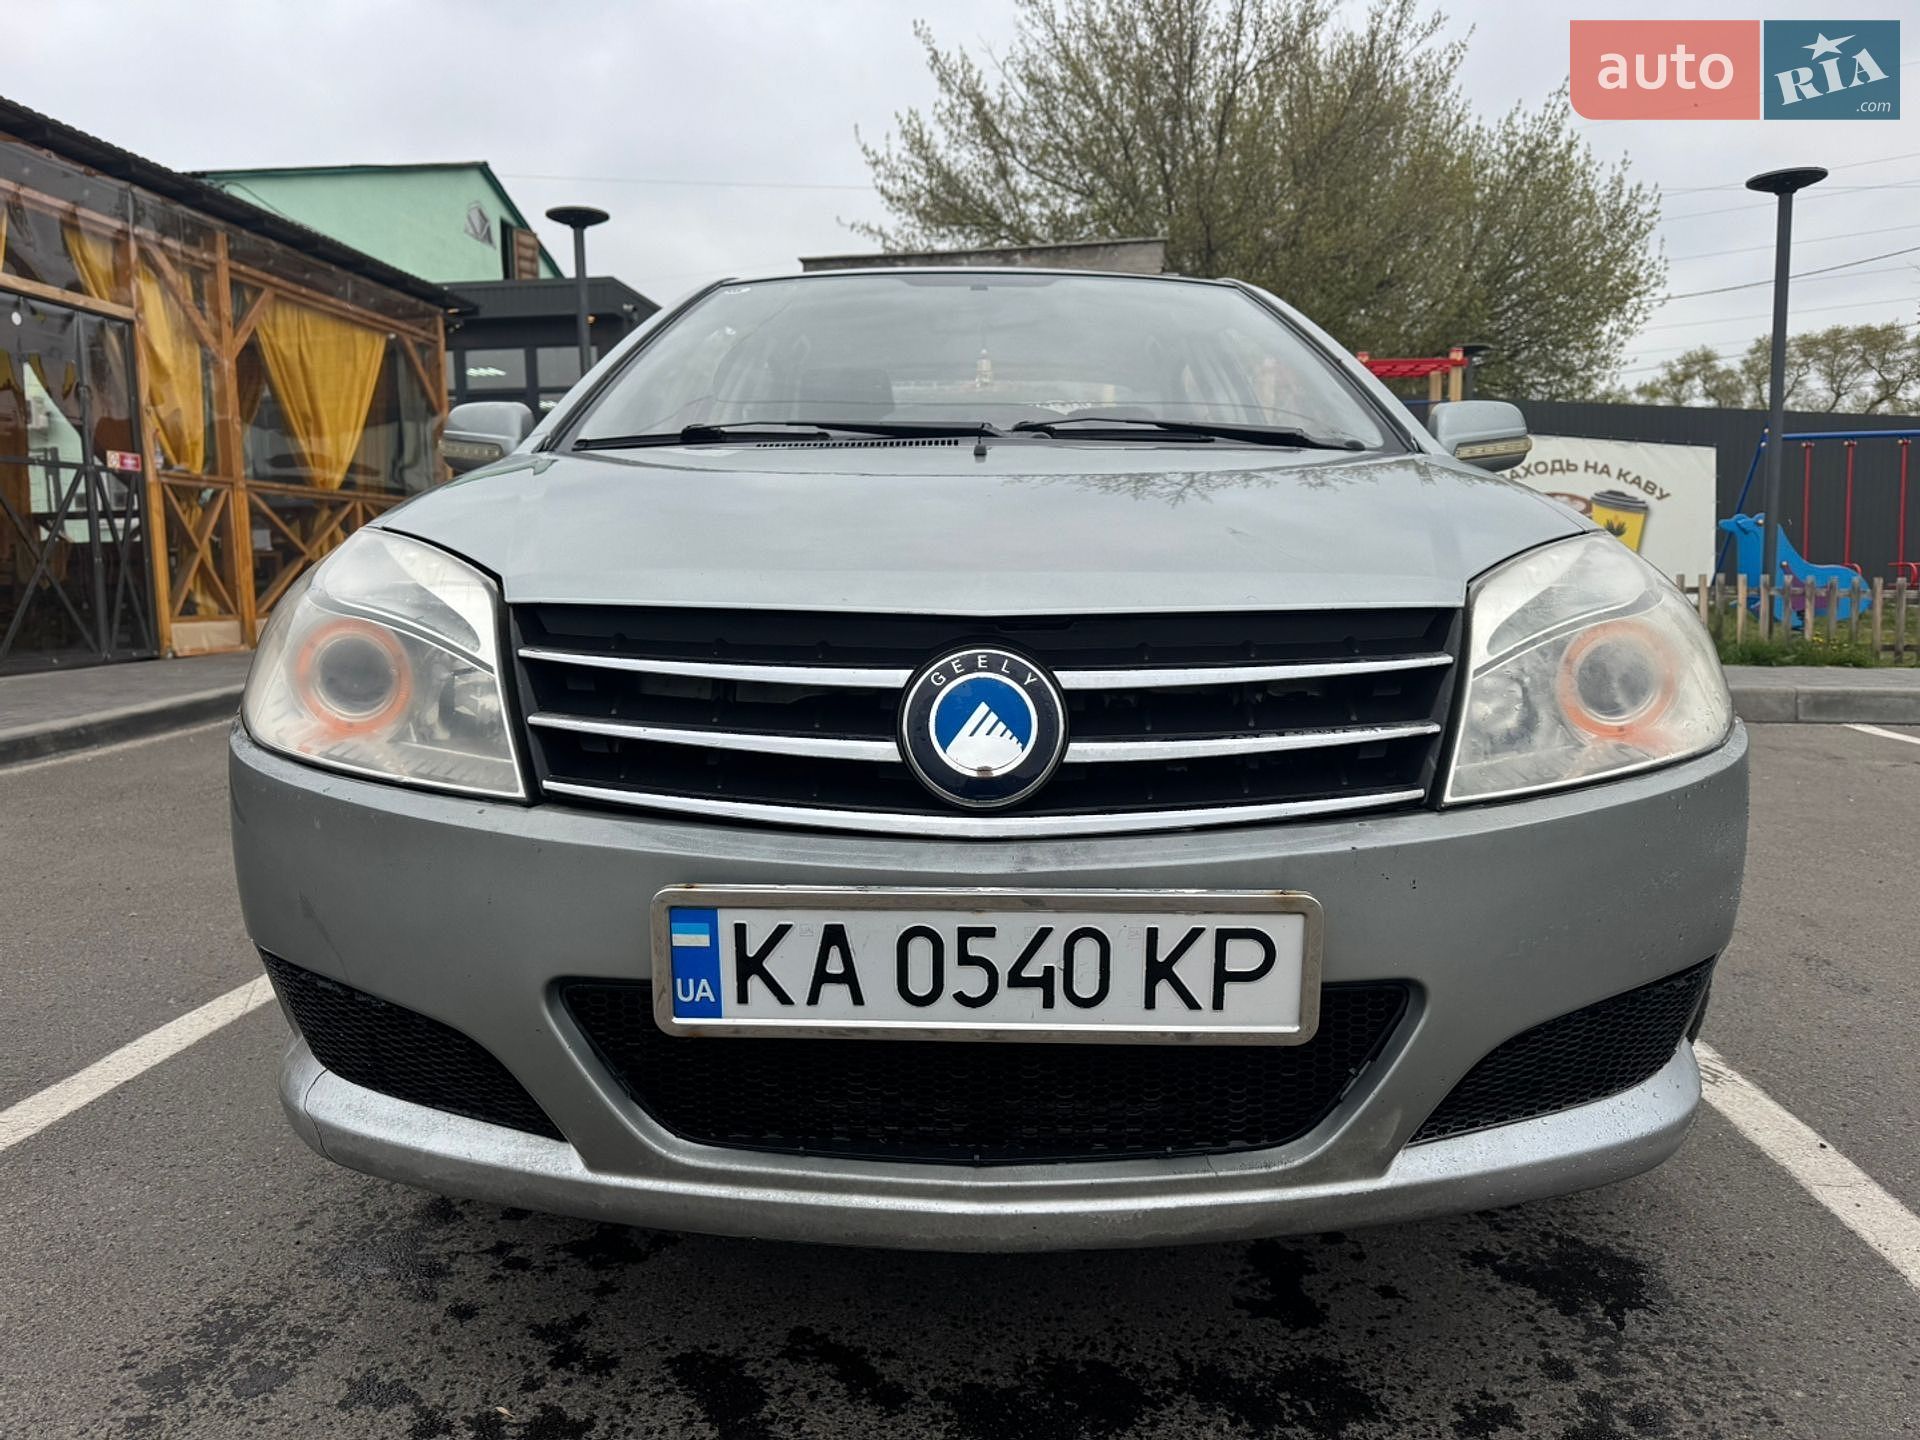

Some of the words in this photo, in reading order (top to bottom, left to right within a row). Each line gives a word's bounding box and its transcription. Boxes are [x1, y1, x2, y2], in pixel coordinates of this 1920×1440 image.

[1502, 459, 1578, 480] АХОДЬ
[1584, 460, 1611, 478] НА
[1616, 467, 1671, 501] КАВУ
[930, 654, 1037, 687] GEELY
[733, 922, 865, 1006] KA
[896, 924, 1111, 1009] 0540
[1144, 926, 1276, 1010] KP
[676, 978, 716, 1003] UA
